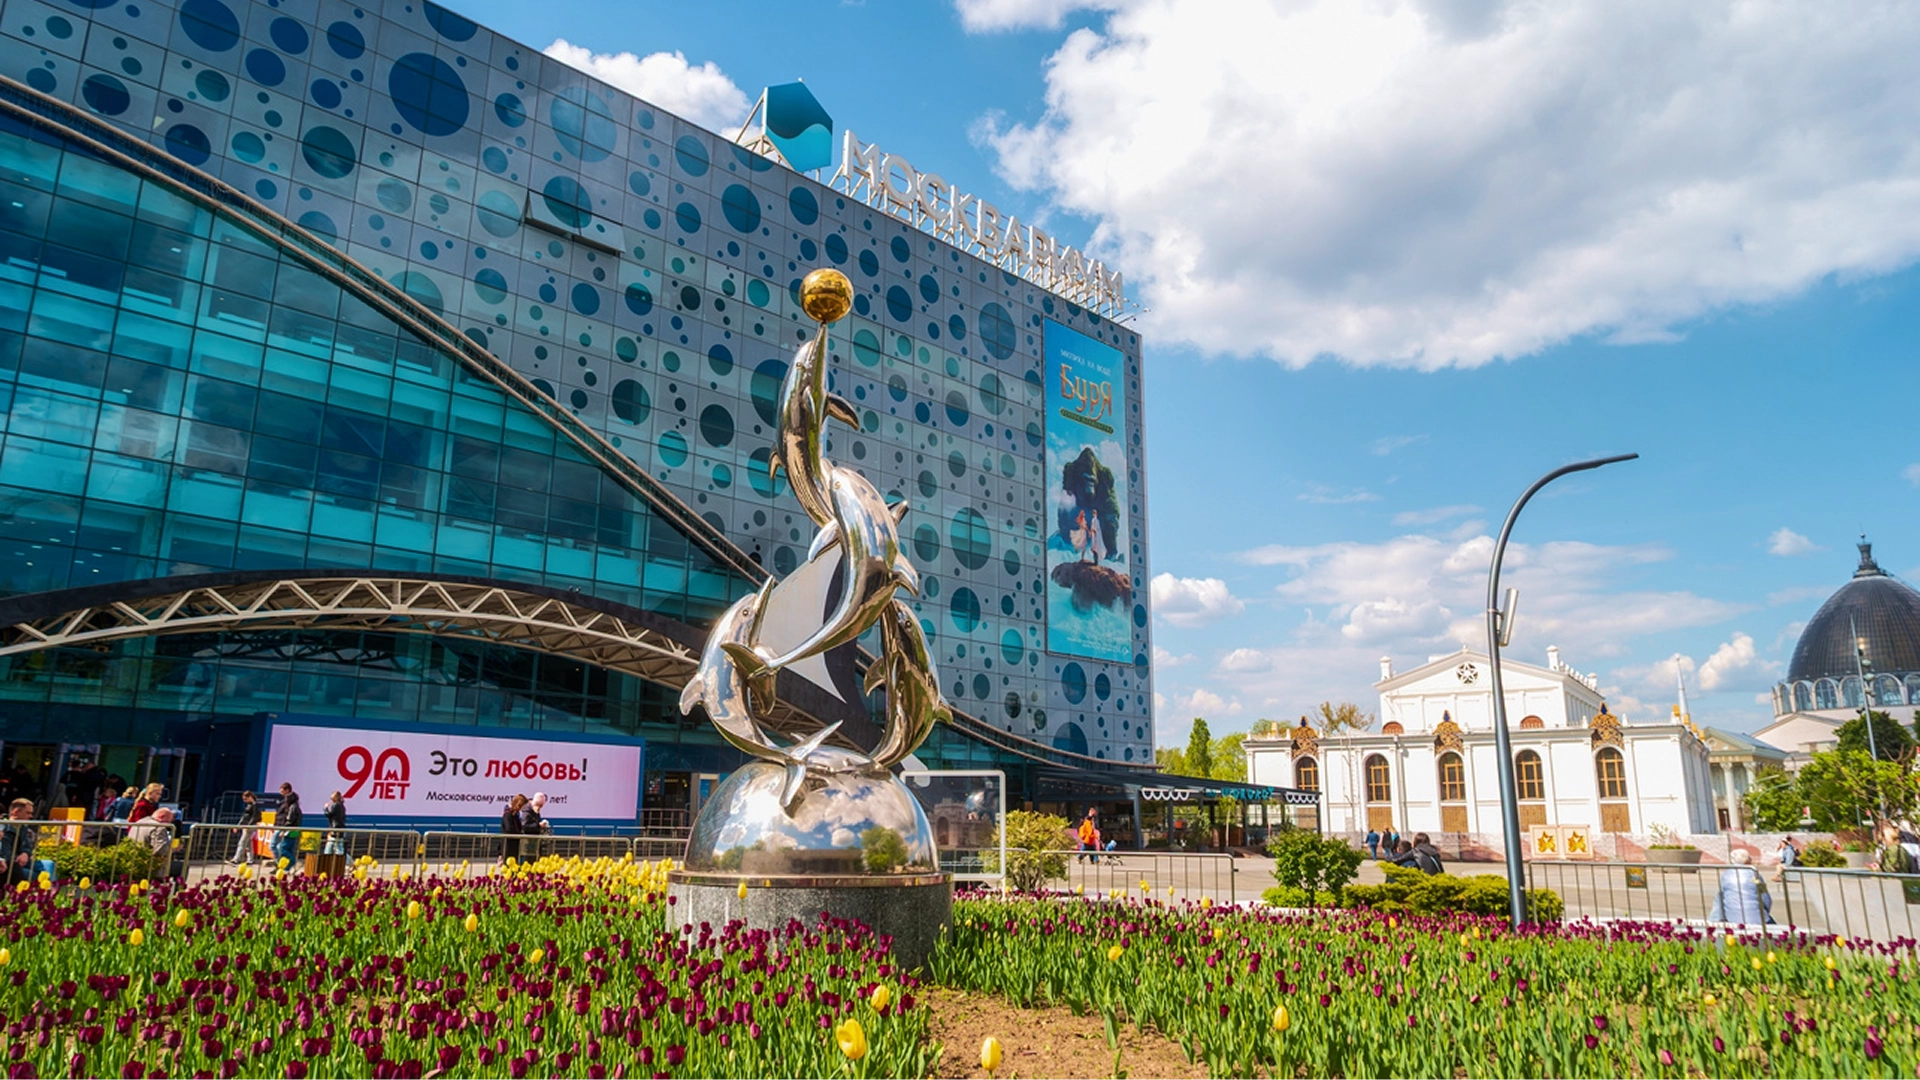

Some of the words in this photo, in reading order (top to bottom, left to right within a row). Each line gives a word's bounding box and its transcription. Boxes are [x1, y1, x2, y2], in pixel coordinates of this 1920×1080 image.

[843, 129, 1123, 310] МОСКВАРИУМ
[337, 745, 410, 799] 90
[428, 750, 478, 777] Это
[484, 754, 588, 781] любовь!
[369, 782, 410, 800] ЛЕТ
[425, 791, 495, 804] Московскому
[549, 795, 568, 804] лет!
